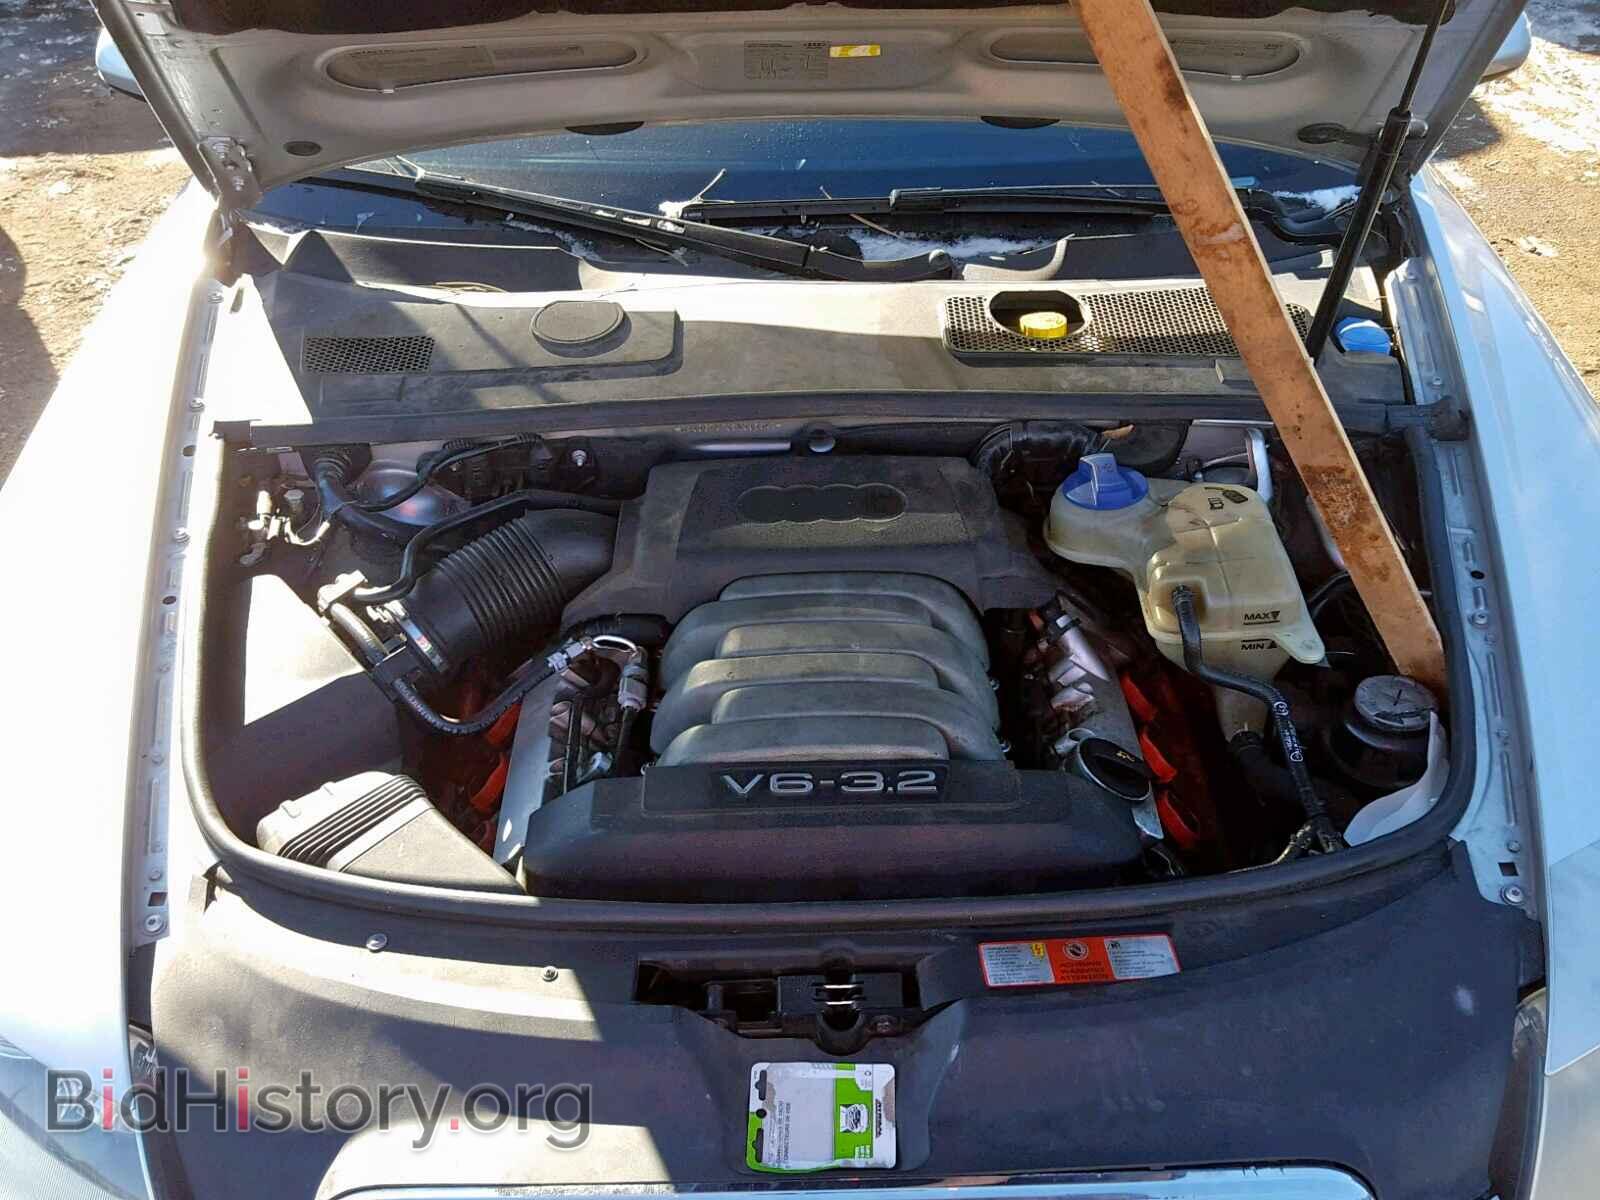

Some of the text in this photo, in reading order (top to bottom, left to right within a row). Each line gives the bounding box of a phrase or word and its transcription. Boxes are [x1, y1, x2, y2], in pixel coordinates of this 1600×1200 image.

[1244, 612, 1270, 621] MAX
[1240, 643, 1265, 651] MIN
[721, 770, 938, 794] V6-3.2
